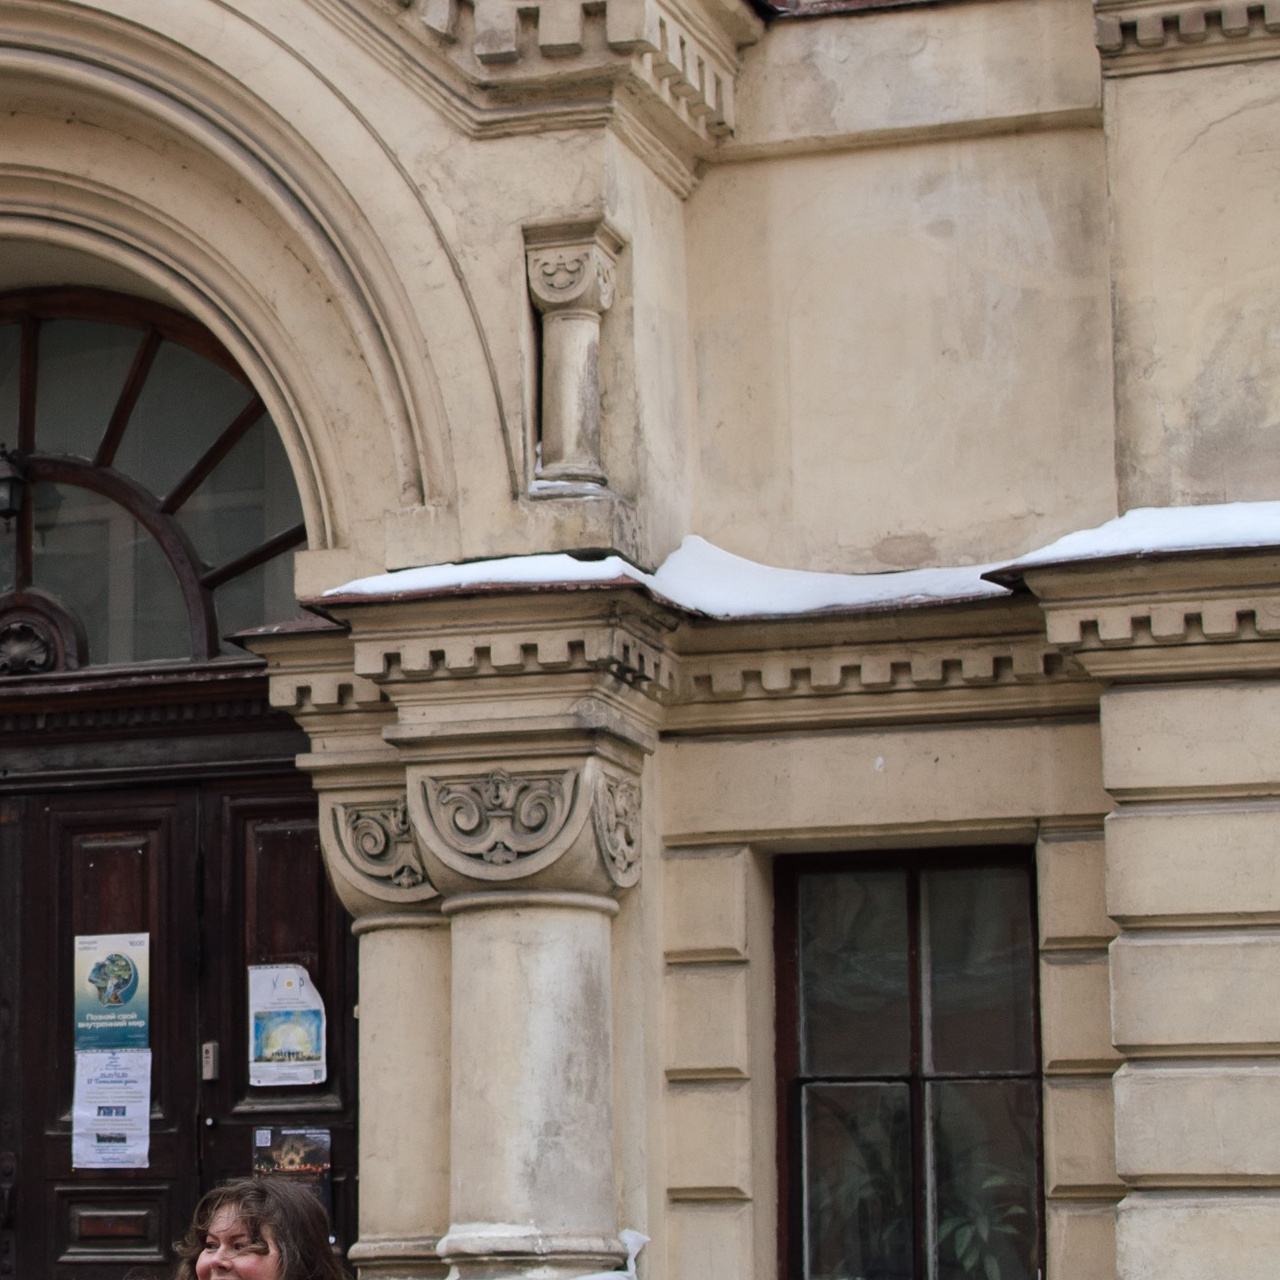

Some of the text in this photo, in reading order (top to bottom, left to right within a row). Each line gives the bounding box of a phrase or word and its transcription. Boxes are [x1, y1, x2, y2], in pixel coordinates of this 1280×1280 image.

[117, 1012, 138, 1020] свой
[78, 1020, 145, 1029] внутренний мир
